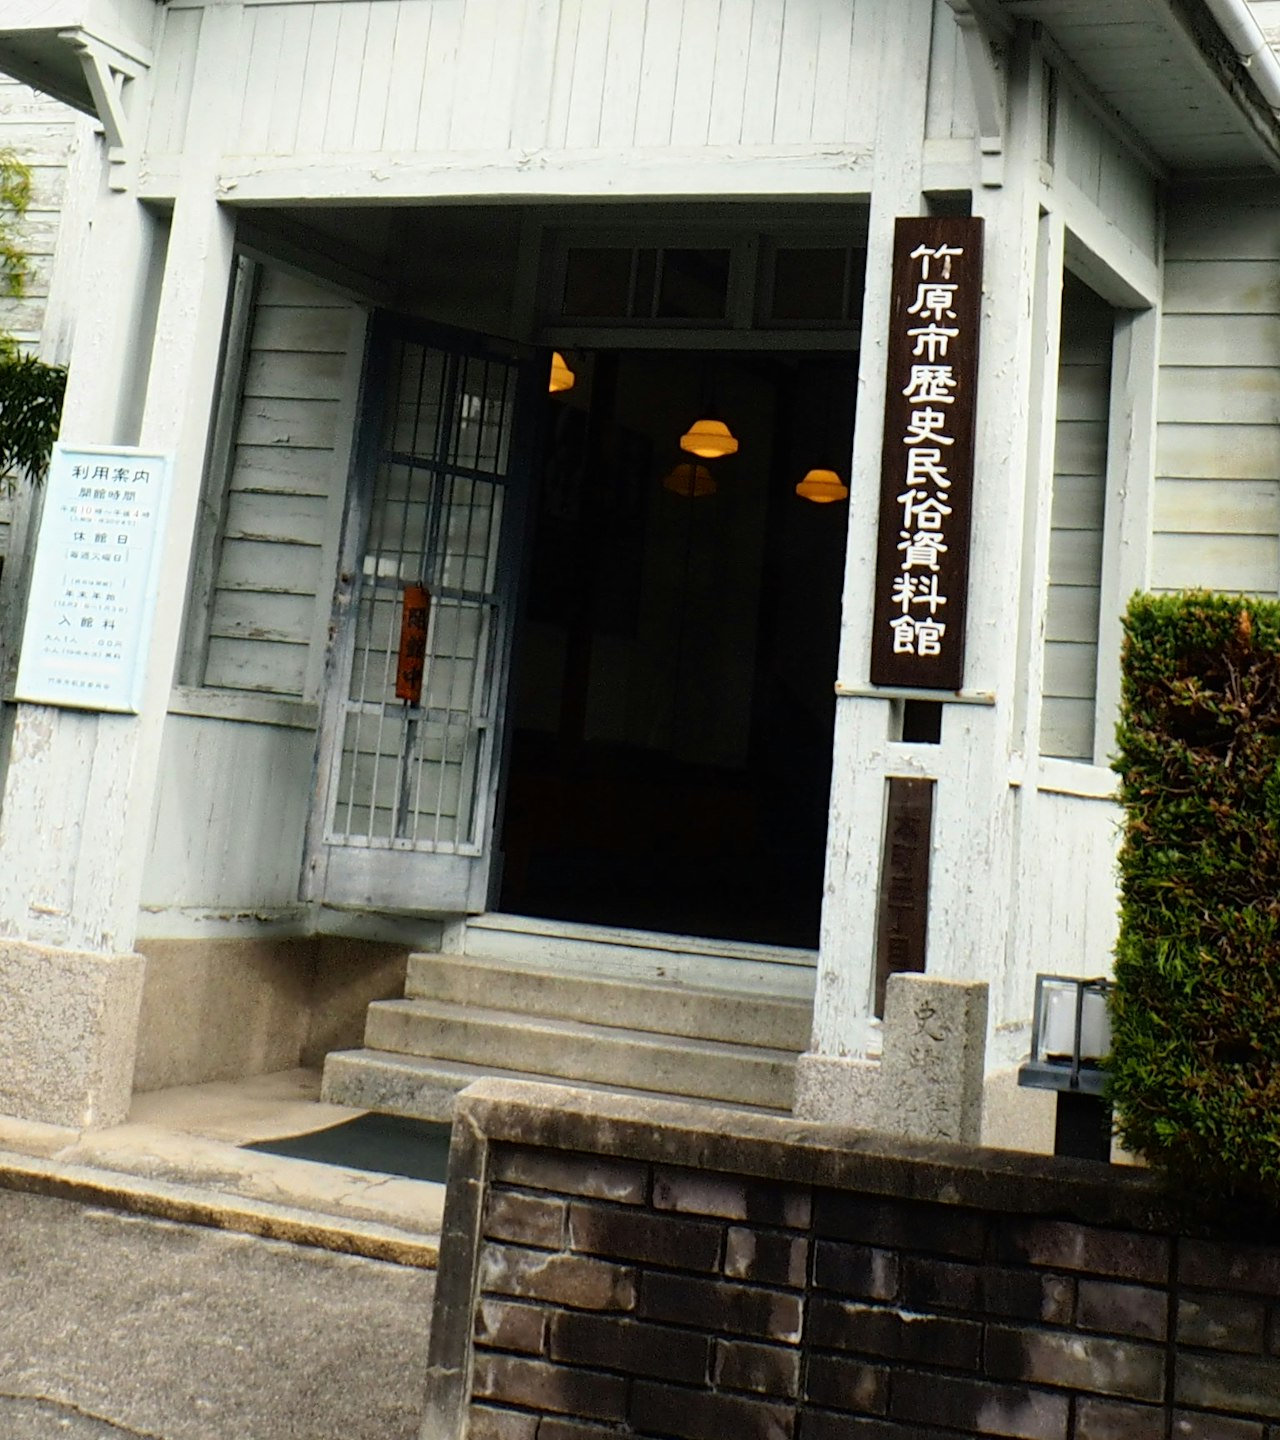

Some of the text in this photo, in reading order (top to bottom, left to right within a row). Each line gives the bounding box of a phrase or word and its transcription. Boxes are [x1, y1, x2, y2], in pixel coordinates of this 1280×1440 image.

[891, 242, 964, 656] 竹原市歴史民俗資料館
[71, 465, 150, 484] 利用案内
[78, 487, 136, 502] 開館時間
[73, 531, 129, 545] 休館日
[58, 614, 116, 632] 入館料
